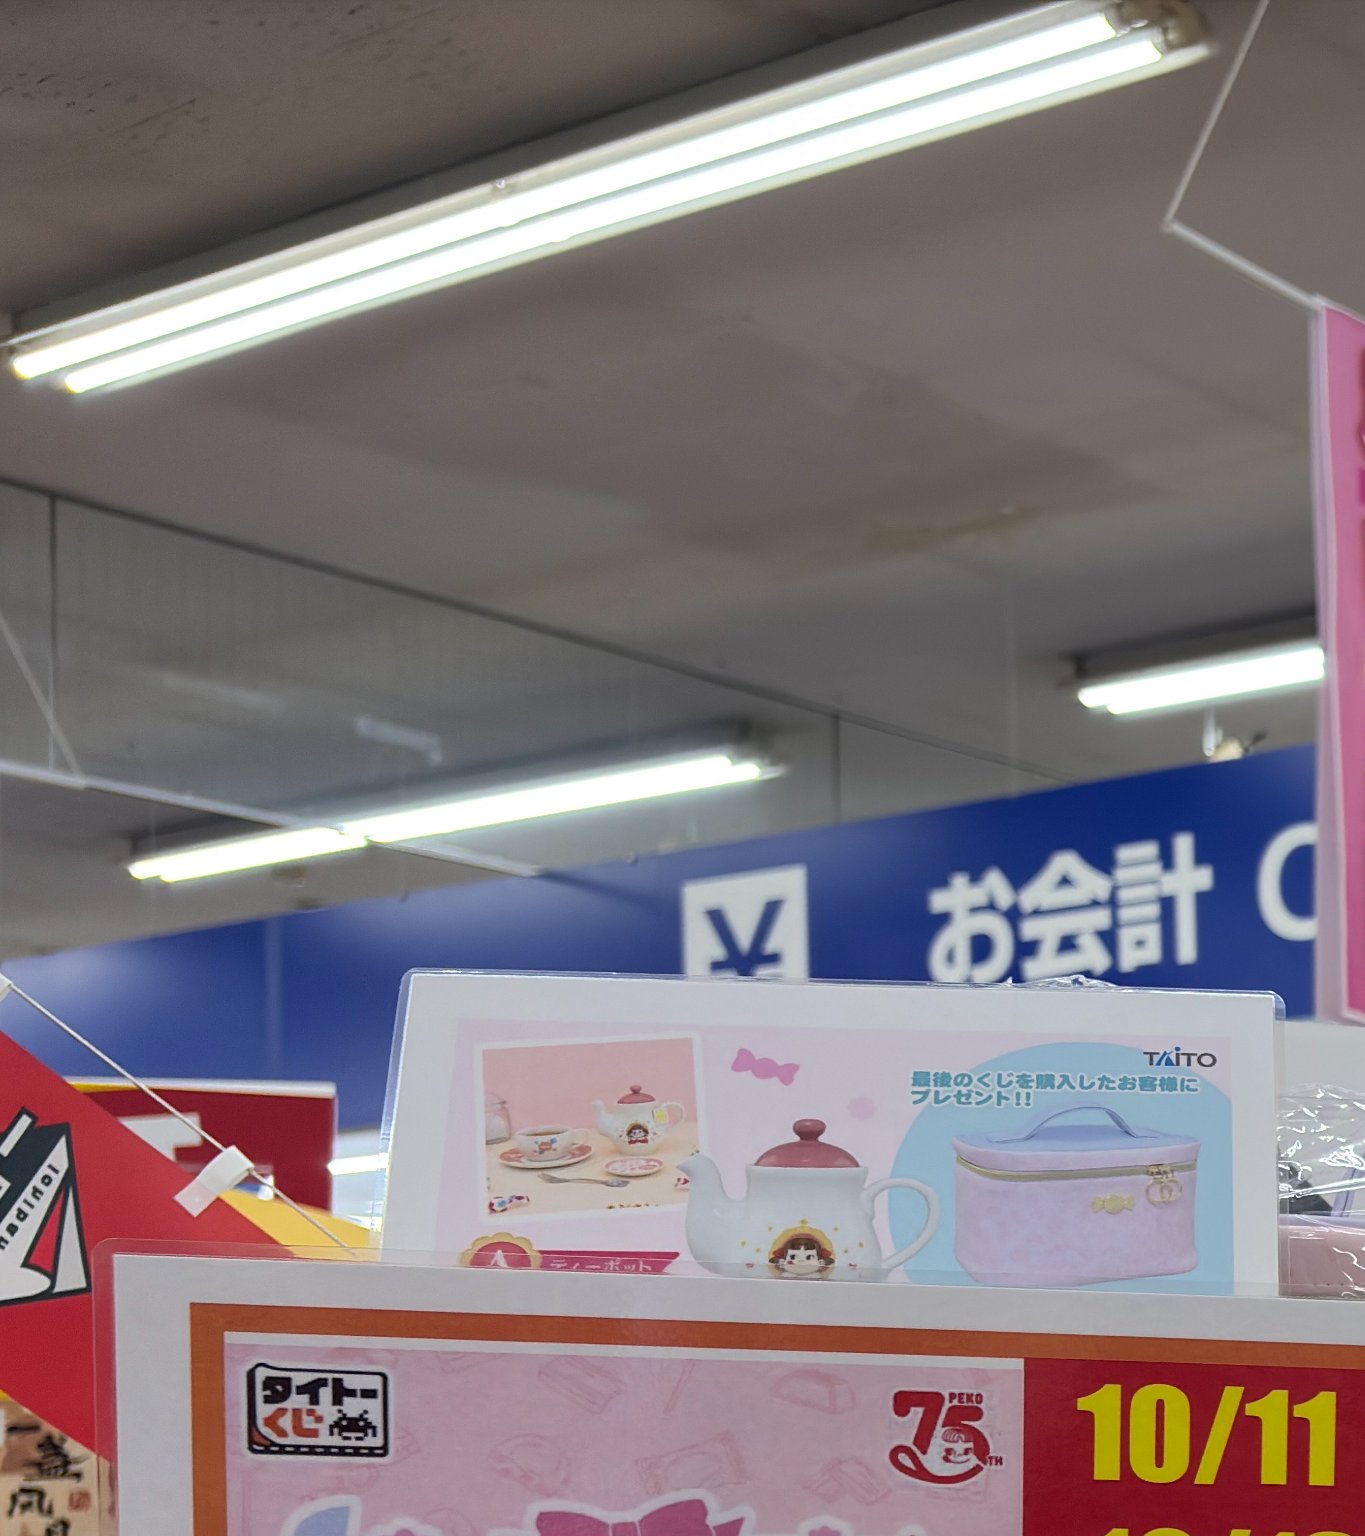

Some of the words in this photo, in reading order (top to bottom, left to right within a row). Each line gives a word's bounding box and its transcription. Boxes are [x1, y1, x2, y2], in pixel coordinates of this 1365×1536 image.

[928, 829, 1214, 984] お会計
[910, 1069, 1200, 1093] 最後のくじを購入したお客様に
[910, 1089, 1033, 1107] プレゼント!!
[261, 1375, 379, 1404] タイトー
[948, 1391, 984, 1406] PEKO
[263, 1408, 324, 1439] くじ
[1076, 1384, 1339, 1487] 10/11
